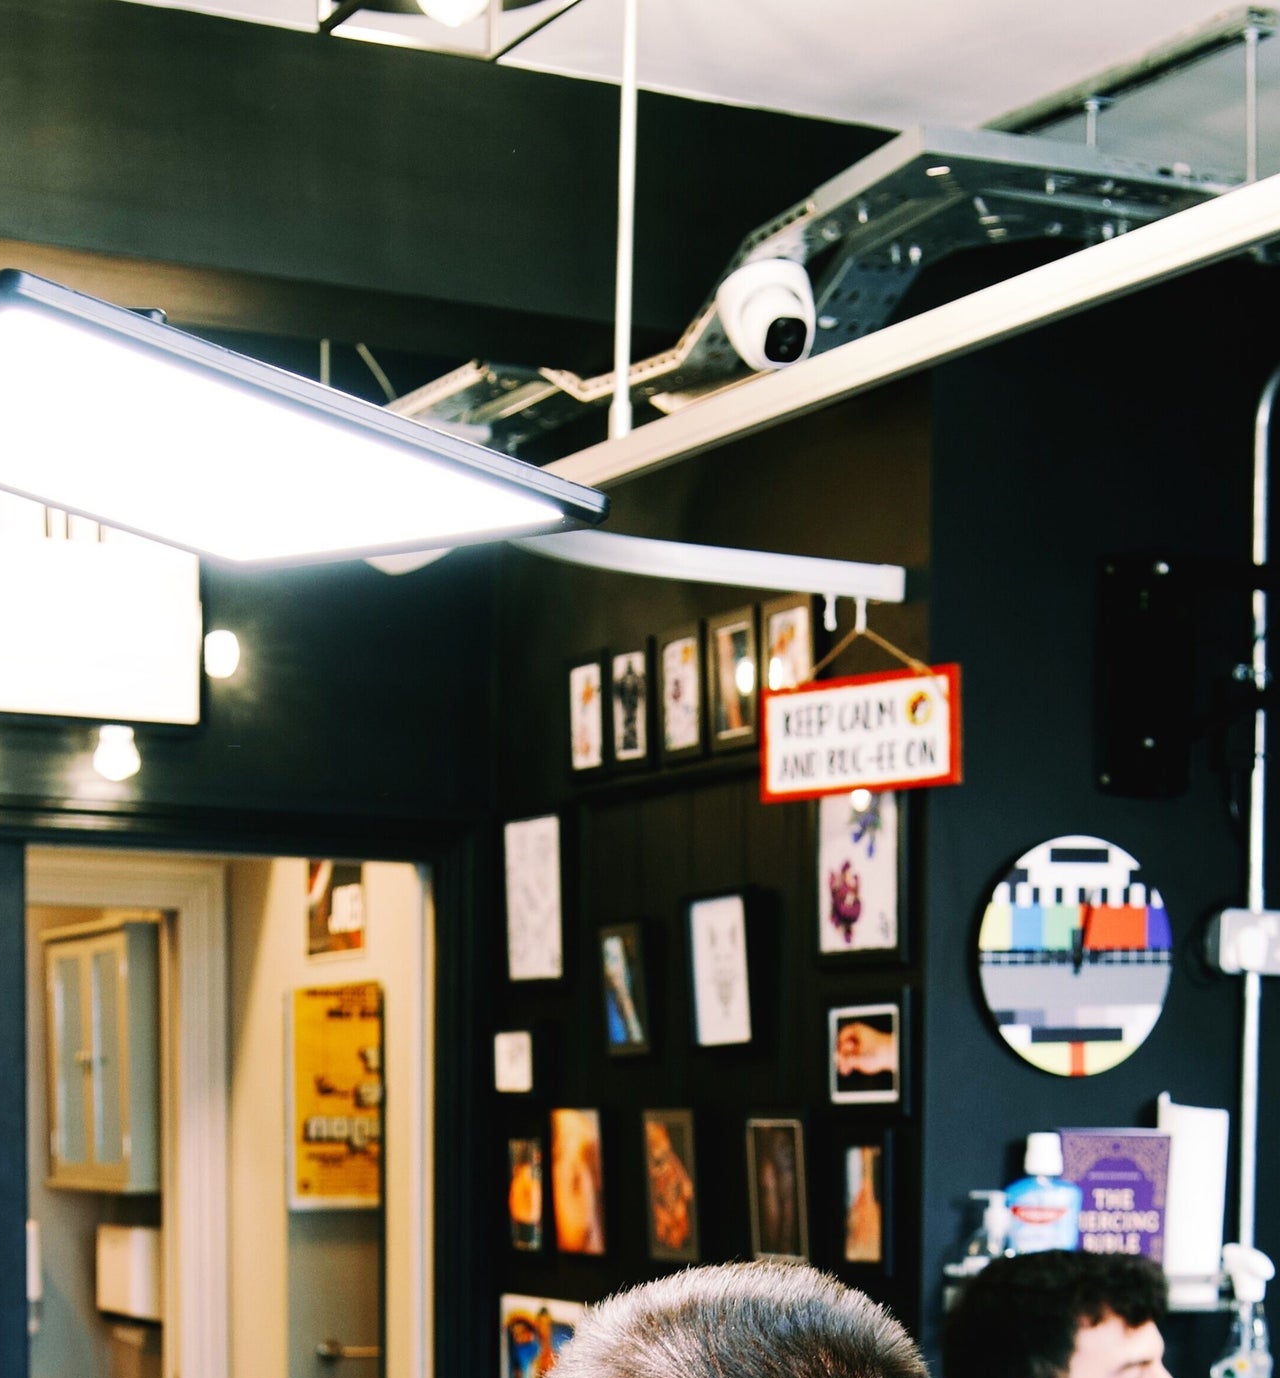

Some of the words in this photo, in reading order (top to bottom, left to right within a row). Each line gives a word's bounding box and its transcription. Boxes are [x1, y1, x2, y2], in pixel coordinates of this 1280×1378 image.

[783, 702, 832, 738] KEEP
[837, 699, 897, 732] CALM
[778, 751, 817, 782] AND
[905, 740, 936, 767] ON
[1092, 1188, 1135, 1211] THE
[1079, 1210, 1160, 1233] IERCING
[1083, 1232, 1141, 1255] BIBLE
